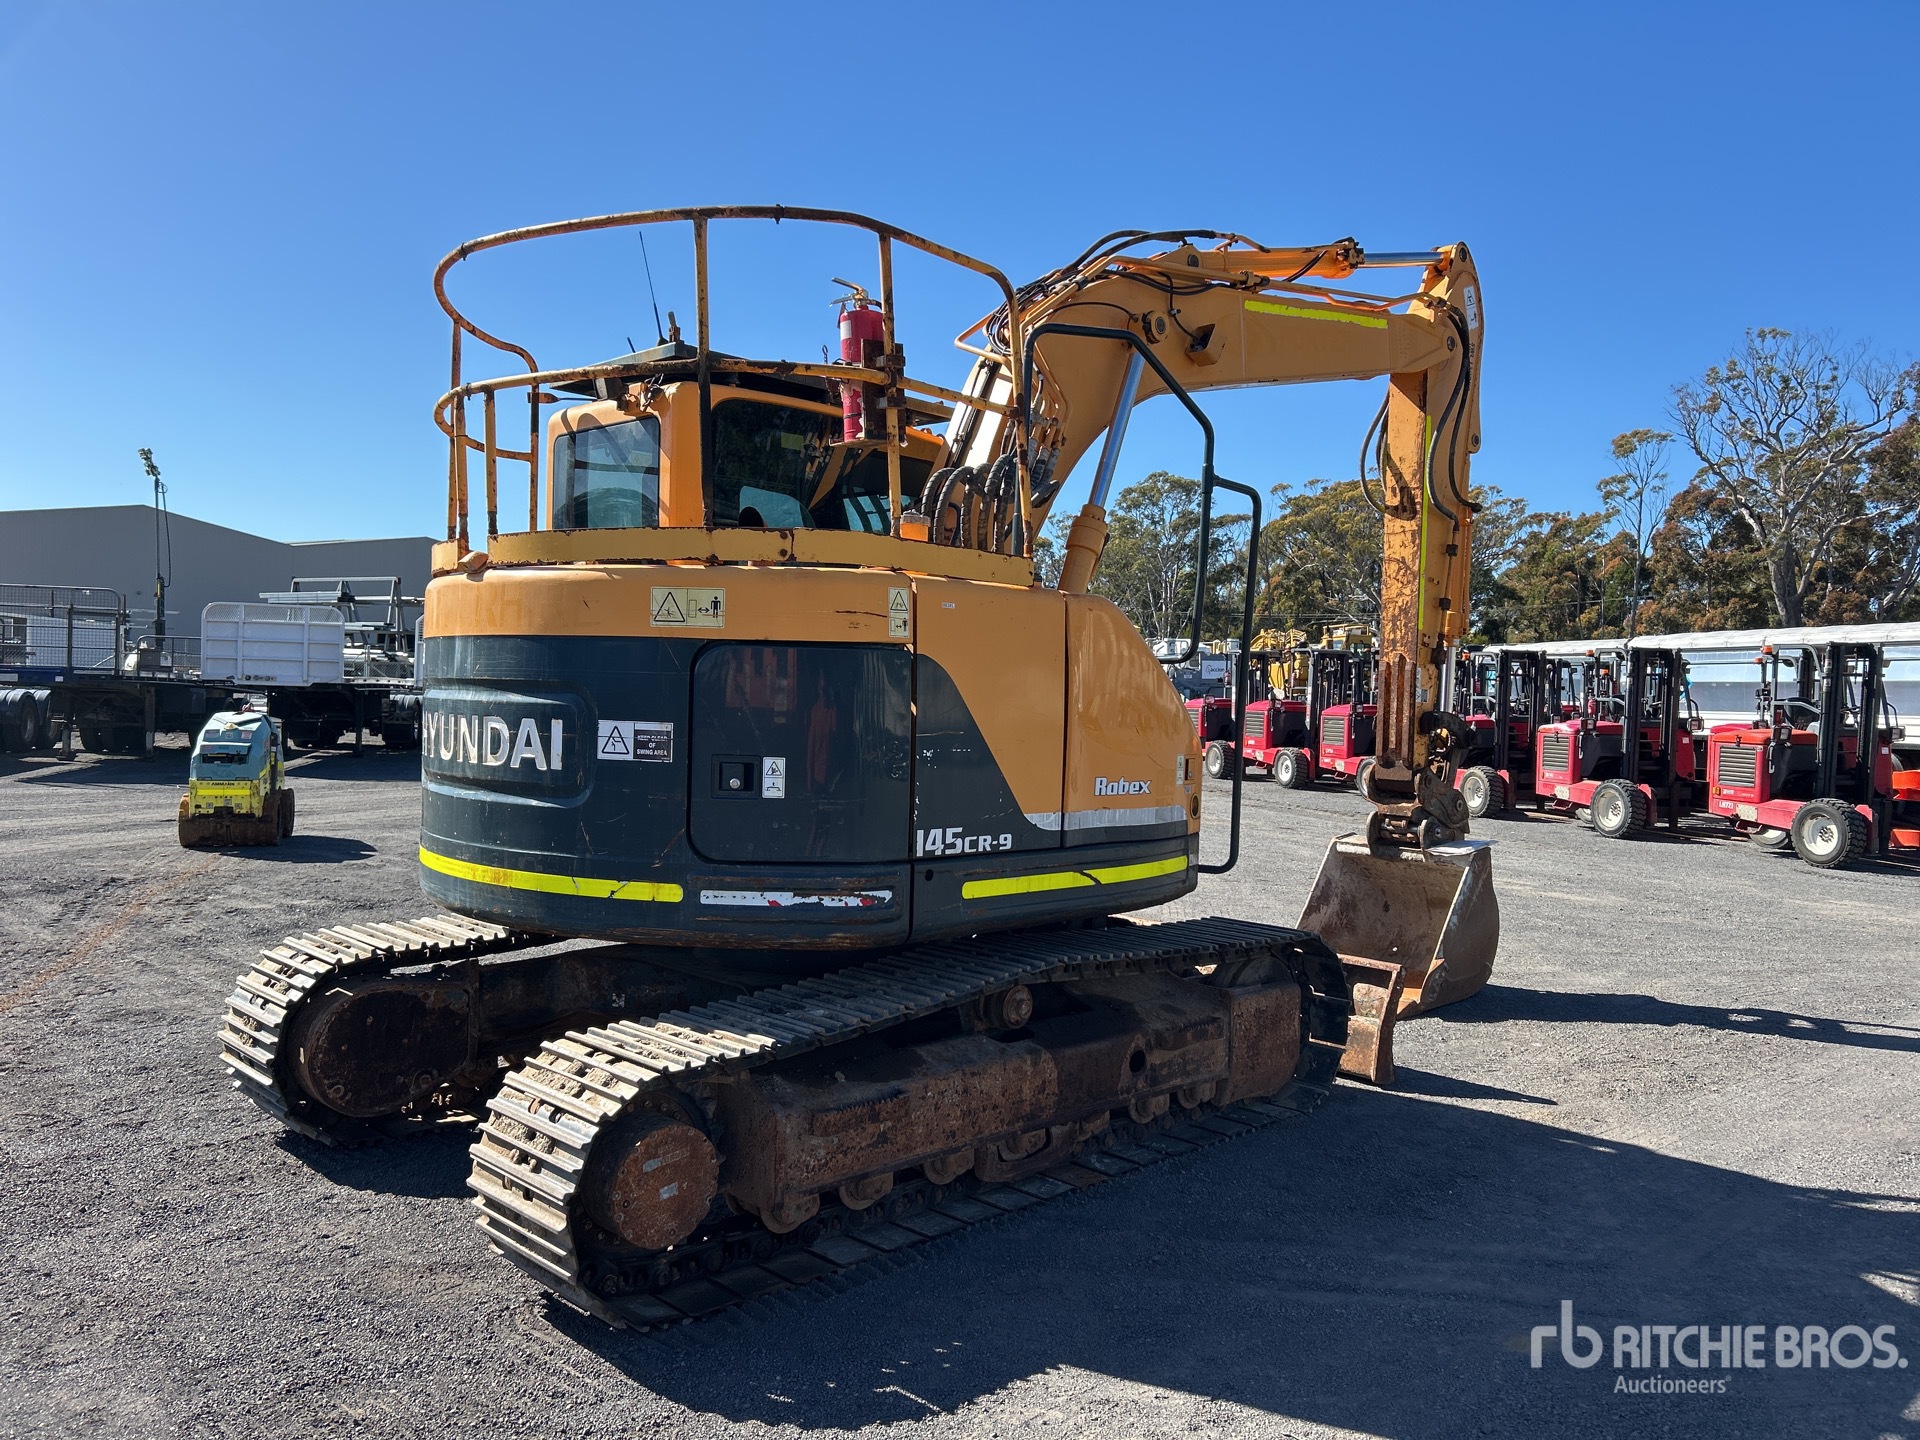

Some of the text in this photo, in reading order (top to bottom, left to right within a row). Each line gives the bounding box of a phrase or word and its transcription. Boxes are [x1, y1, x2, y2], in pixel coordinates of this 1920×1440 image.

[422, 711, 563, 770] HYUNDAI
[636, 748, 653, 756] SWING
[1094, 776, 1152, 796] Robex
